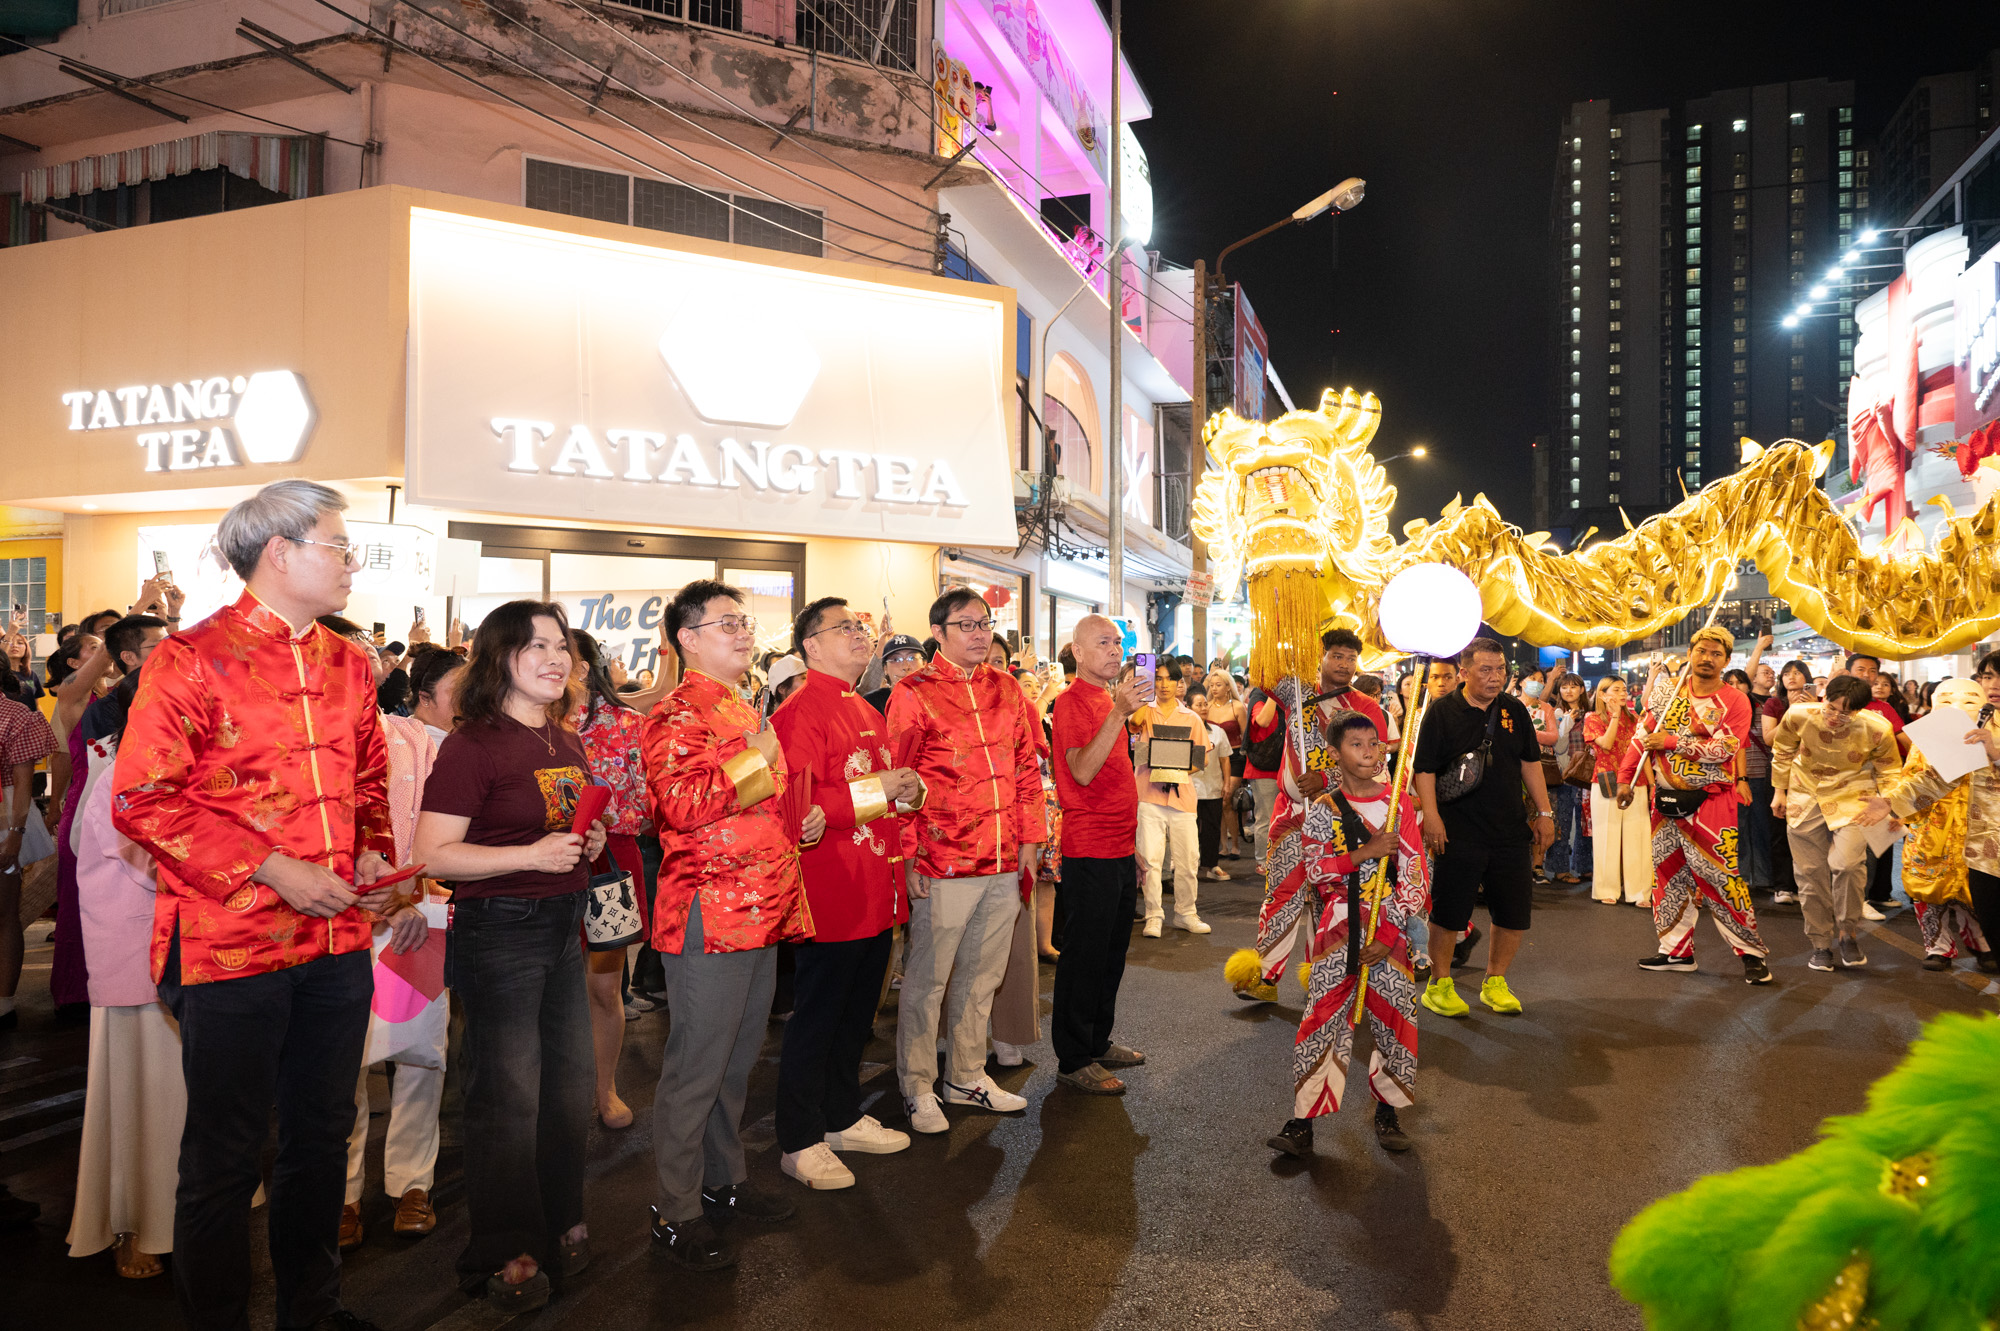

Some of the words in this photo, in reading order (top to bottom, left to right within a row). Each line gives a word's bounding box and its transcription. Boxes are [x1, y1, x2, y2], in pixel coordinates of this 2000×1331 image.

[136, 425, 235, 473] TEA
[362, 542, 395, 571] 唐
[579, 592, 632, 631] The
[638, 595, 664, 631] E
[628, 637, 660, 672] Fr
